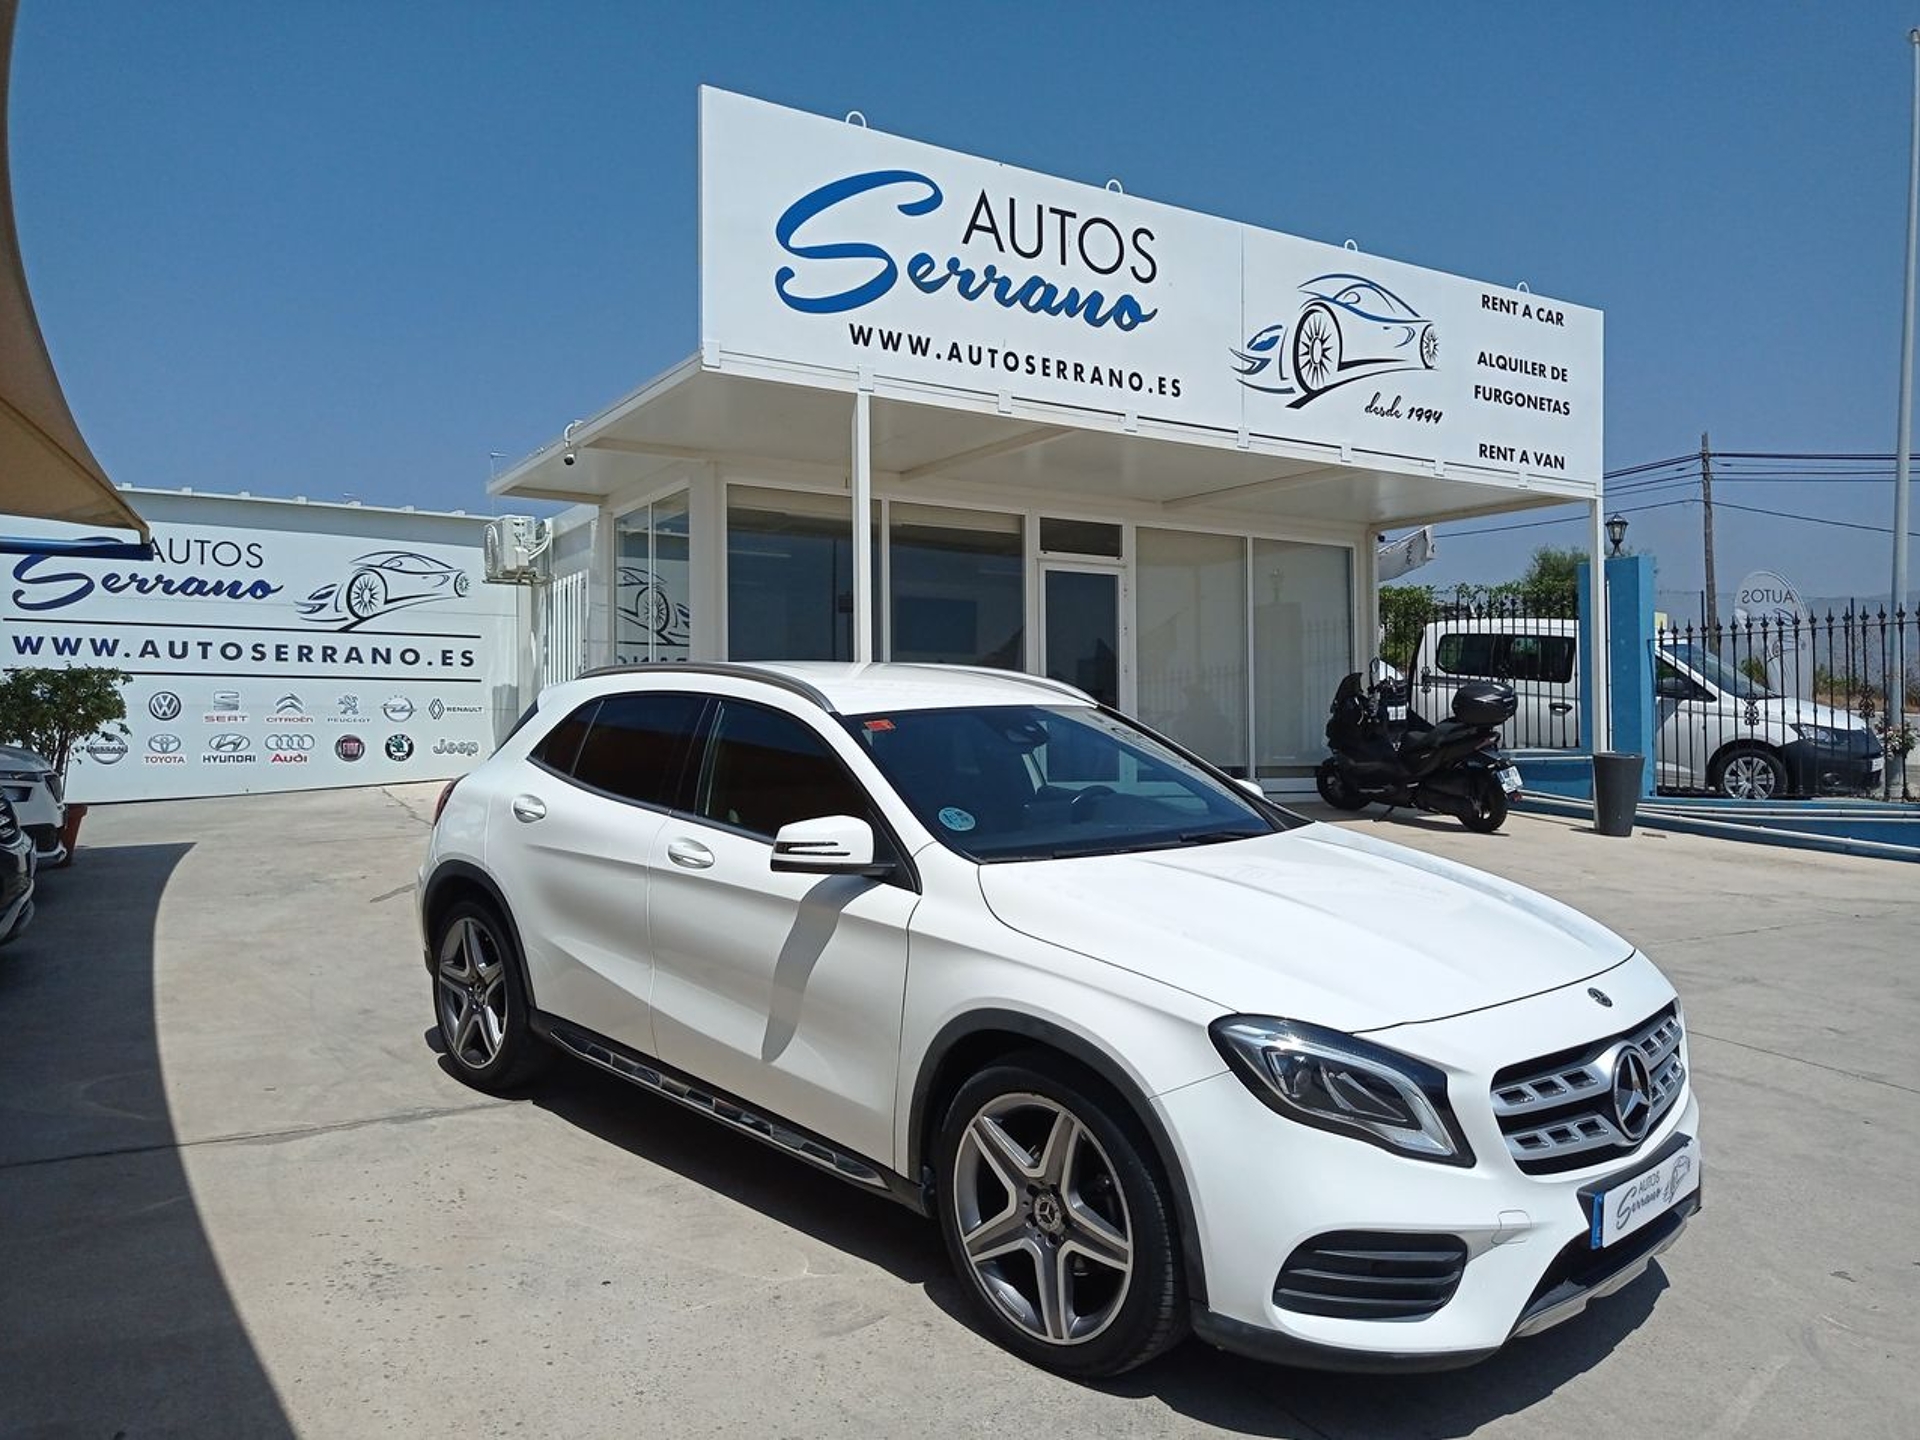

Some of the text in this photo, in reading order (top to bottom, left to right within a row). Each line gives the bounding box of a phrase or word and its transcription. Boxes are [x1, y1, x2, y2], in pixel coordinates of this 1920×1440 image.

[775, 170, 1158, 332] Serrano
[961, 189, 1157, 284] AUTOS
[1482, 294, 1564, 327] RENT A CAR
[849, 323, 1182, 398] WWW.AUTOSERRANO.ES
[1477, 351, 1568, 382] ALQUILER DE
[1365, 391, 1443, 424] desde 1994
[1474, 384, 1570, 416] FURGONETAS
[1479, 443, 1565, 470] RENT A VAN
[12, 537, 283, 611] Serrano
[12, 635, 475, 667] WWW.AUTOSERRANO.ES
[204, 715, 248, 723] SEAT
[144, 756, 185, 764] TOYOTA
[203, 755, 256, 763] HYUNDAI
[271, 754, 307, 763] Audi
[432, 739, 479, 756] Jeep
